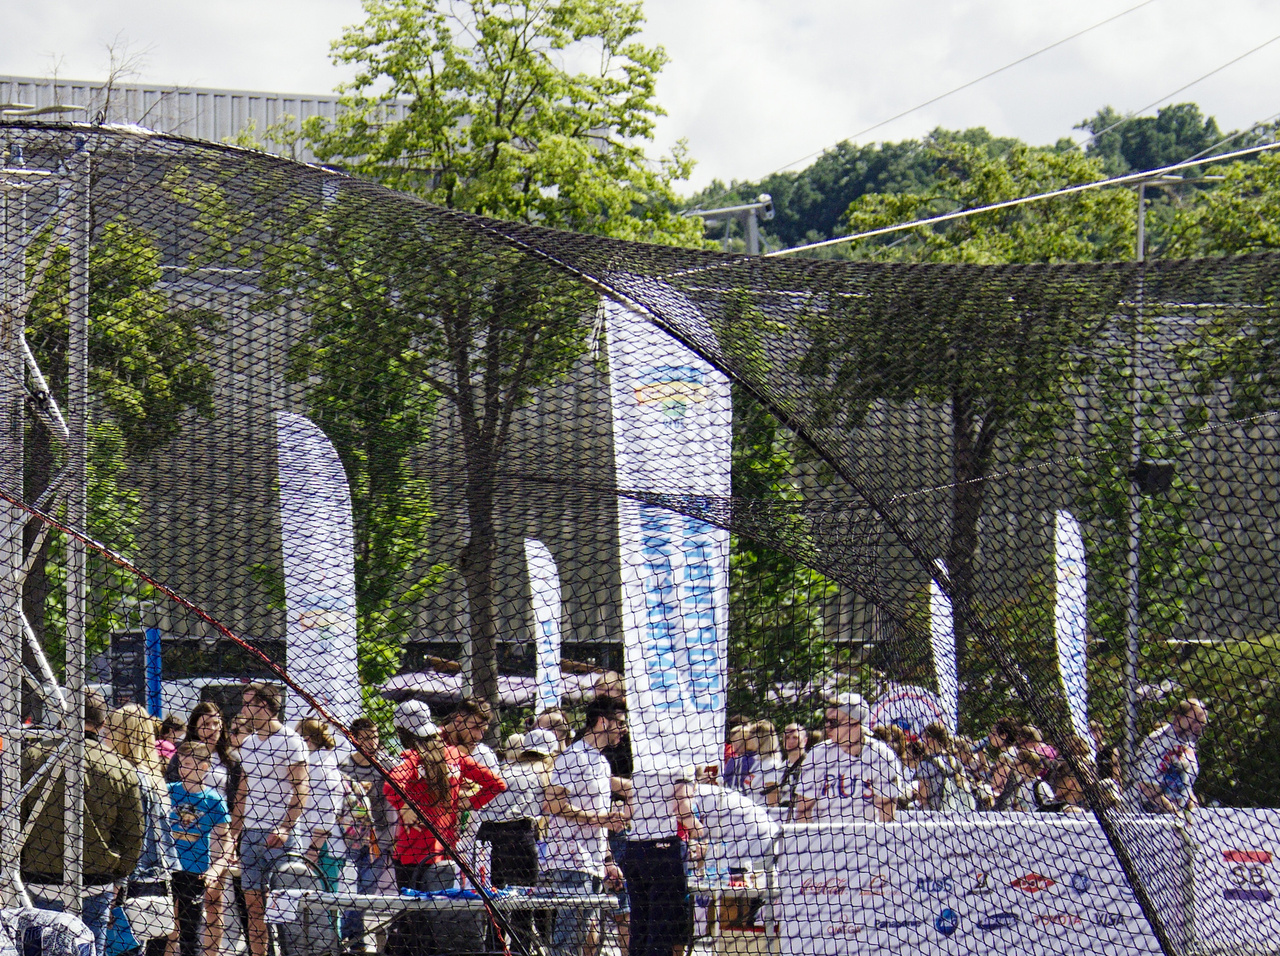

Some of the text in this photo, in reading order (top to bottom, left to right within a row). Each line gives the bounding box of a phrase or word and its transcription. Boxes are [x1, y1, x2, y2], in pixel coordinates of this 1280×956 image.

[822, 774, 874, 799] RUS
[1034, 915, 1082, 926] TOYOTA
[1094, 912, 1126, 927] VISA
